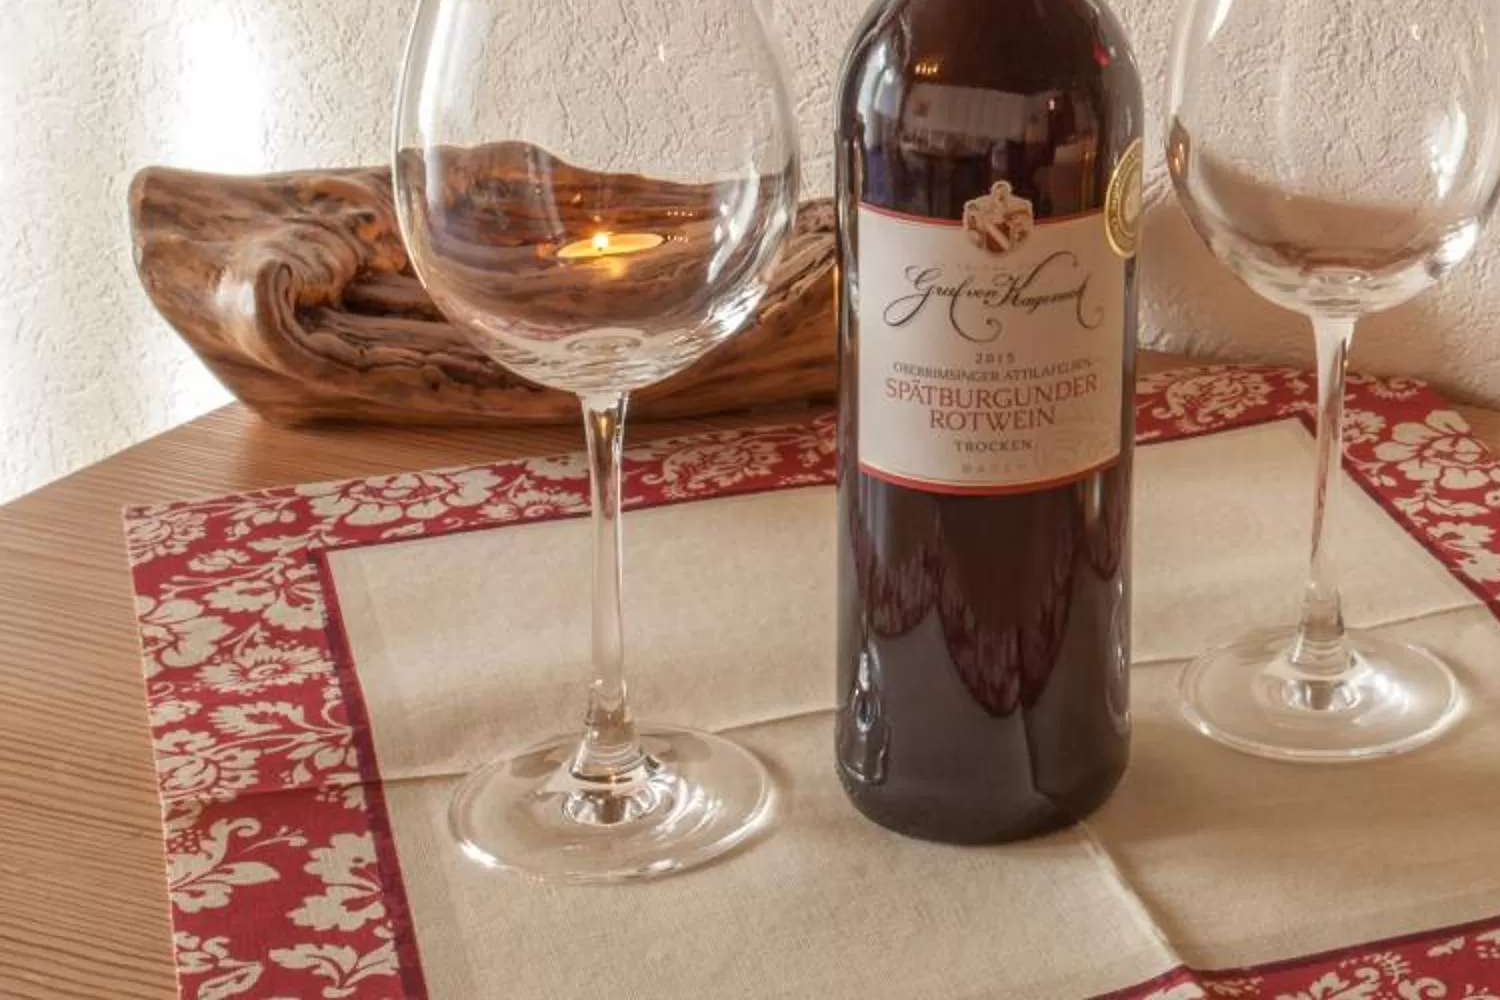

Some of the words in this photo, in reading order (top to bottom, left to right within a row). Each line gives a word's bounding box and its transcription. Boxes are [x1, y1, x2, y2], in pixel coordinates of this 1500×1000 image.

[885, 374, 1098, 409] SPÄTBURGUNDER
[929, 407, 1057, 432] ROTWEIN
[953, 439, 1033, 453] TROCKEN
